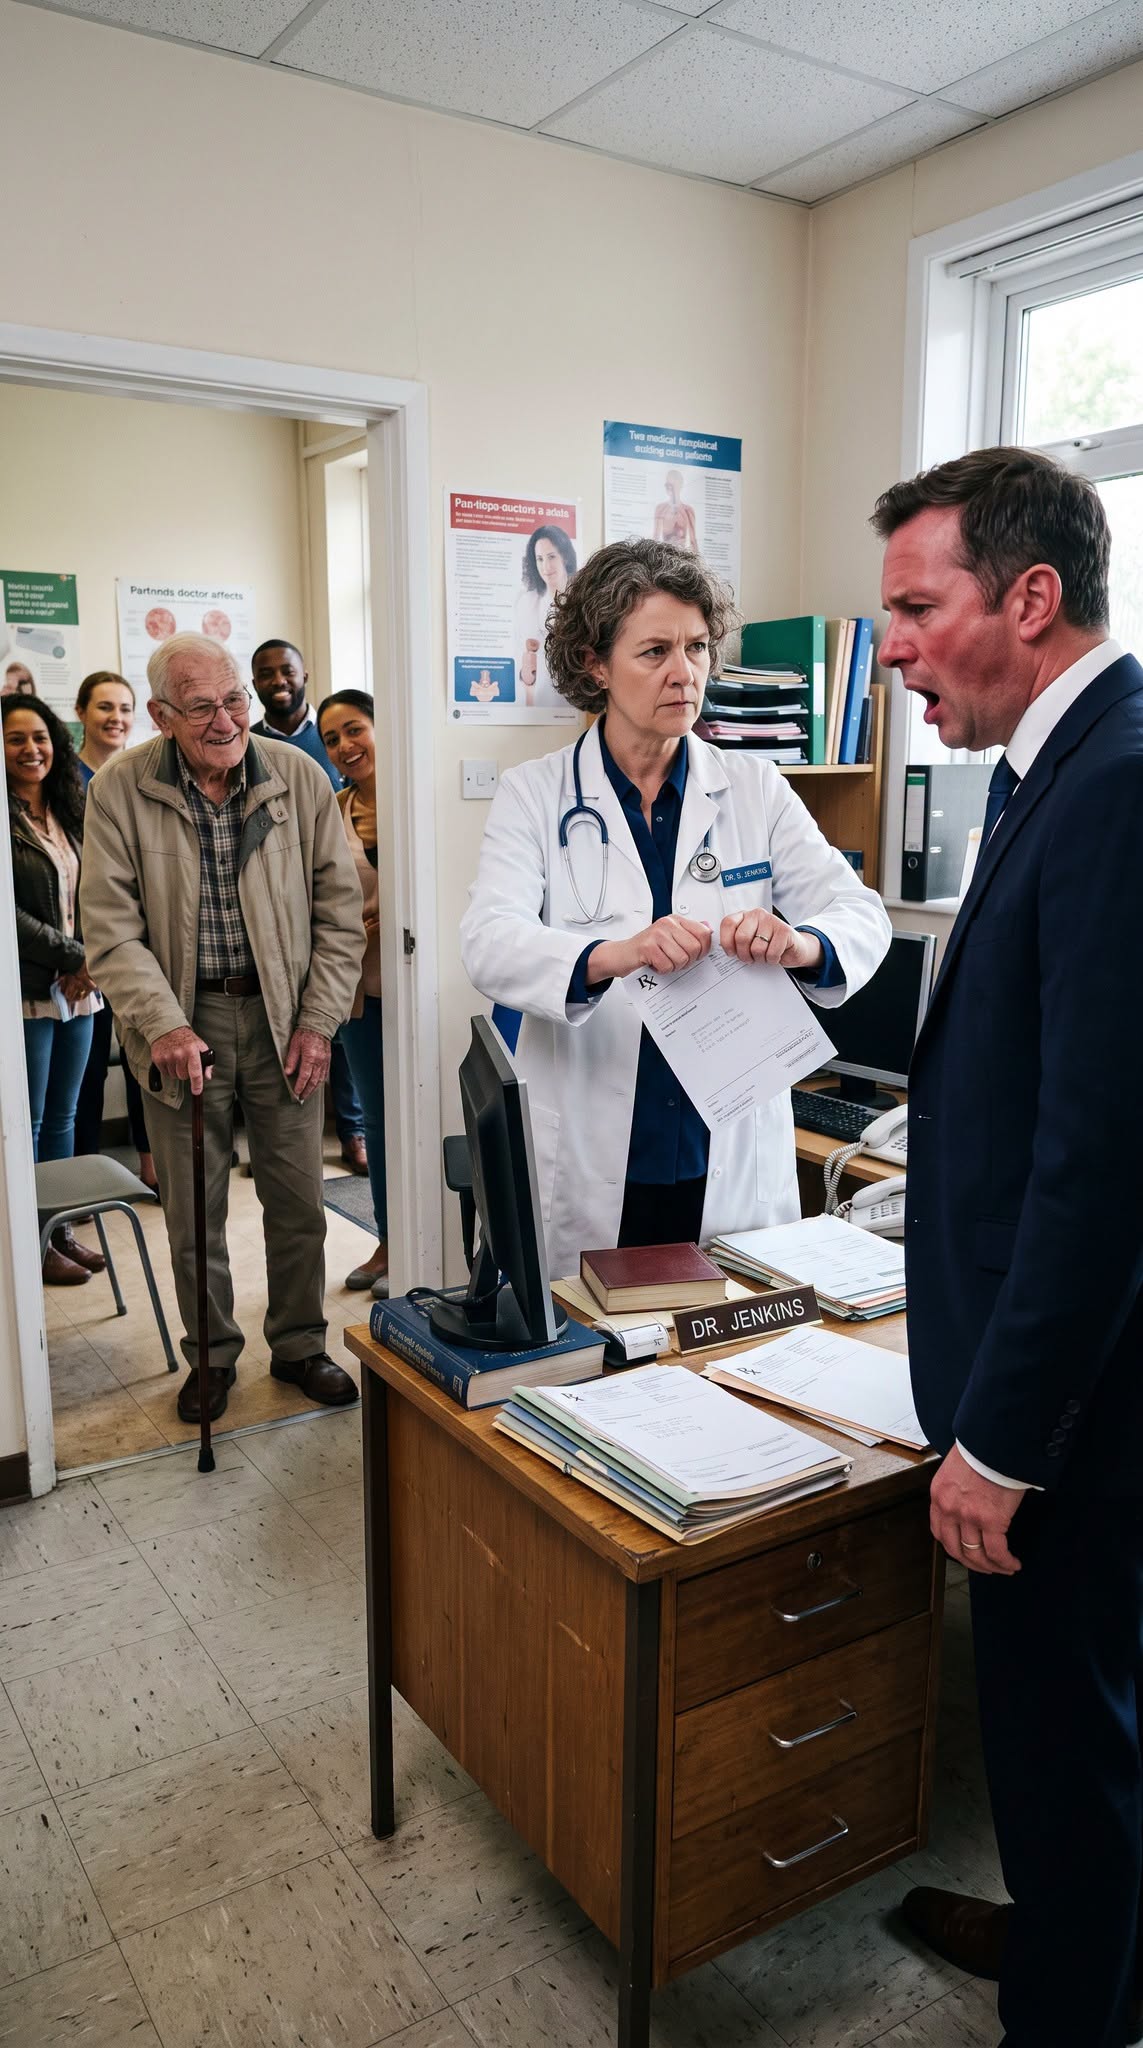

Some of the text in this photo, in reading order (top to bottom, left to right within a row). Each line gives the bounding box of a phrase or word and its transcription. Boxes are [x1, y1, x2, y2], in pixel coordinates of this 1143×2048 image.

[177, 588, 208, 599] doctor
[211, 590, 244, 601] affects
[691, 1316, 724, 1339] DR.
[731, 1298, 805, 1332] JENKINS
